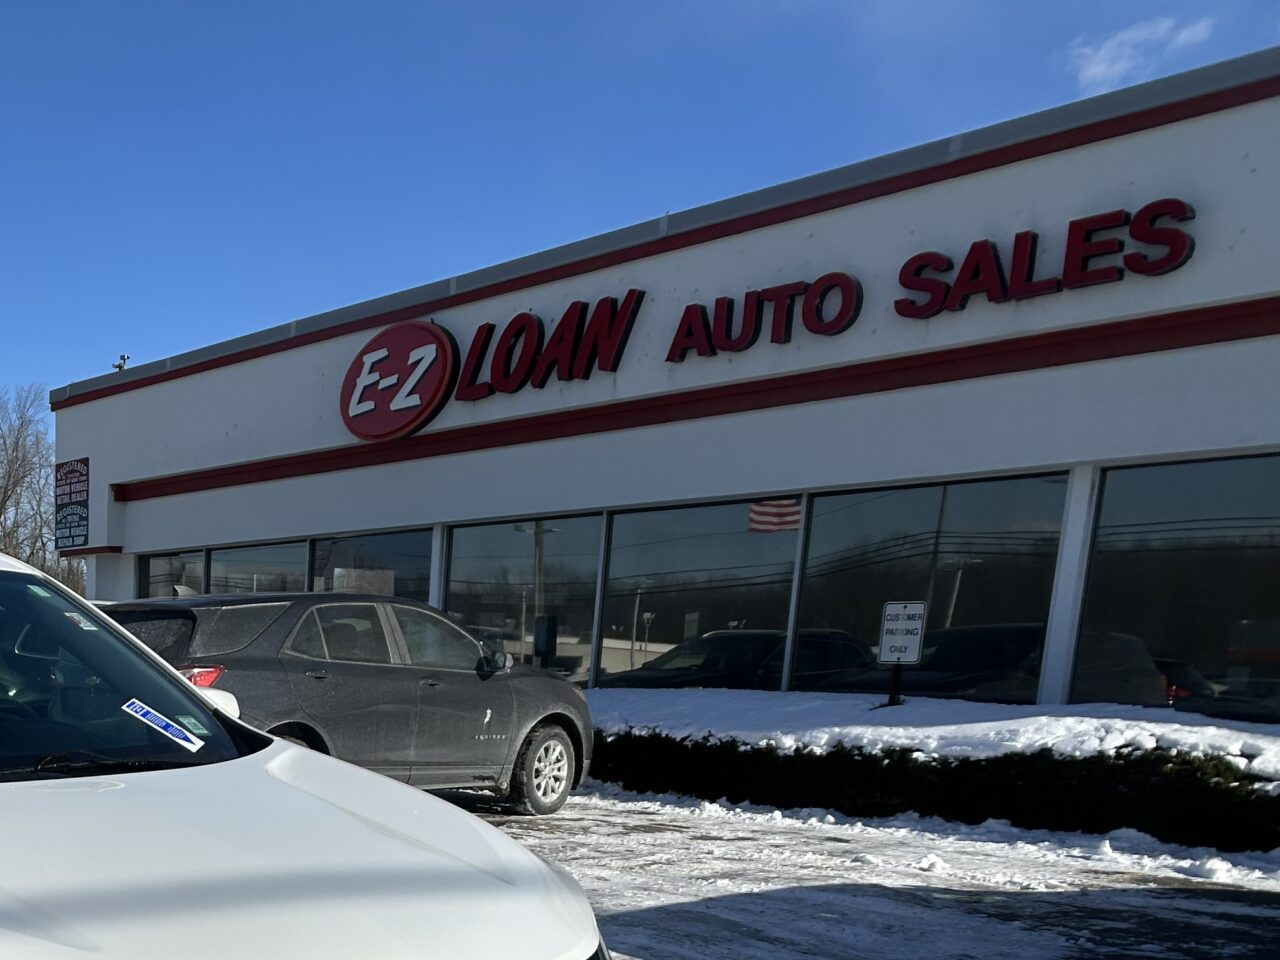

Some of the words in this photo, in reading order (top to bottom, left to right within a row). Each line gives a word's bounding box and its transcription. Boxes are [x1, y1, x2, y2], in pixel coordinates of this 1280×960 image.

[348, 343, 437, 418] E-Z
[454, 288, 646, 402] LOAN
[665, 271, 864, 362] AUTO
[894, 197, 1196, 319] SALES
[57, 461, 87, 480] REGISTERED
[71, 481, 88, 492] VEHICLE
[71, 491, 87, 502] DEALER
[57, 505, 87, 521] REGISTERED
[71, 526, 87, 536] VEHICLE
[58, 538, 73, 547] REPAIR
[74, 535, 85, 545] SHOP
[889, 645, 908, 653] ONLY
